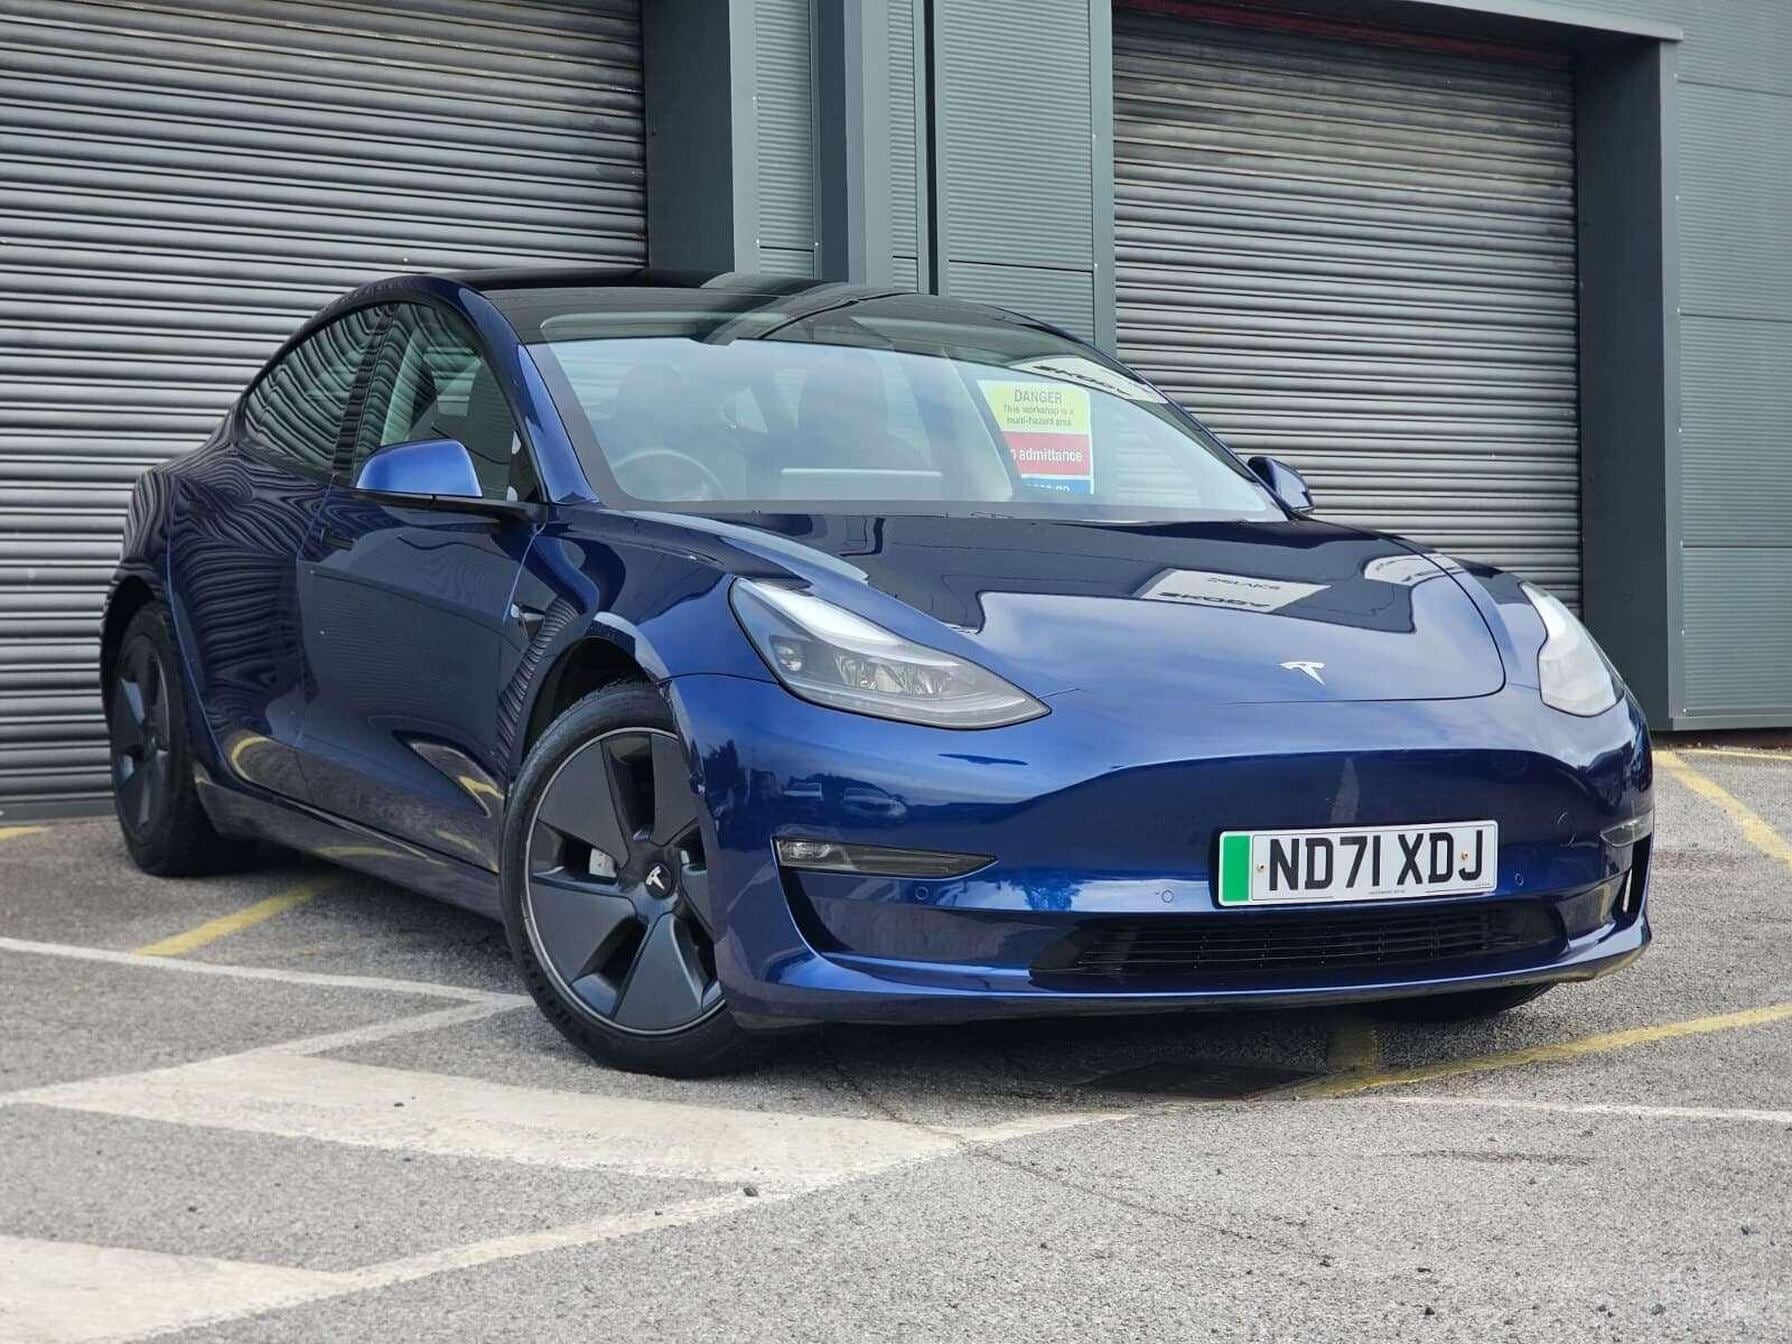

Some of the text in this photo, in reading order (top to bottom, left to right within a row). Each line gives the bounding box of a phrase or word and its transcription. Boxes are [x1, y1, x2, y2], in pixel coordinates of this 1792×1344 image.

[1014, 389, 1062, 403] DANGER
[1004, 404, 1020, 414] This
[1022, 405, 1059, 416] workshop
[1006, 416, 1072, 427] multi-hazard area
[1019, 447, 1083, 462] admittance
[1268, 830, 1483, 891] ND71 XDJ
